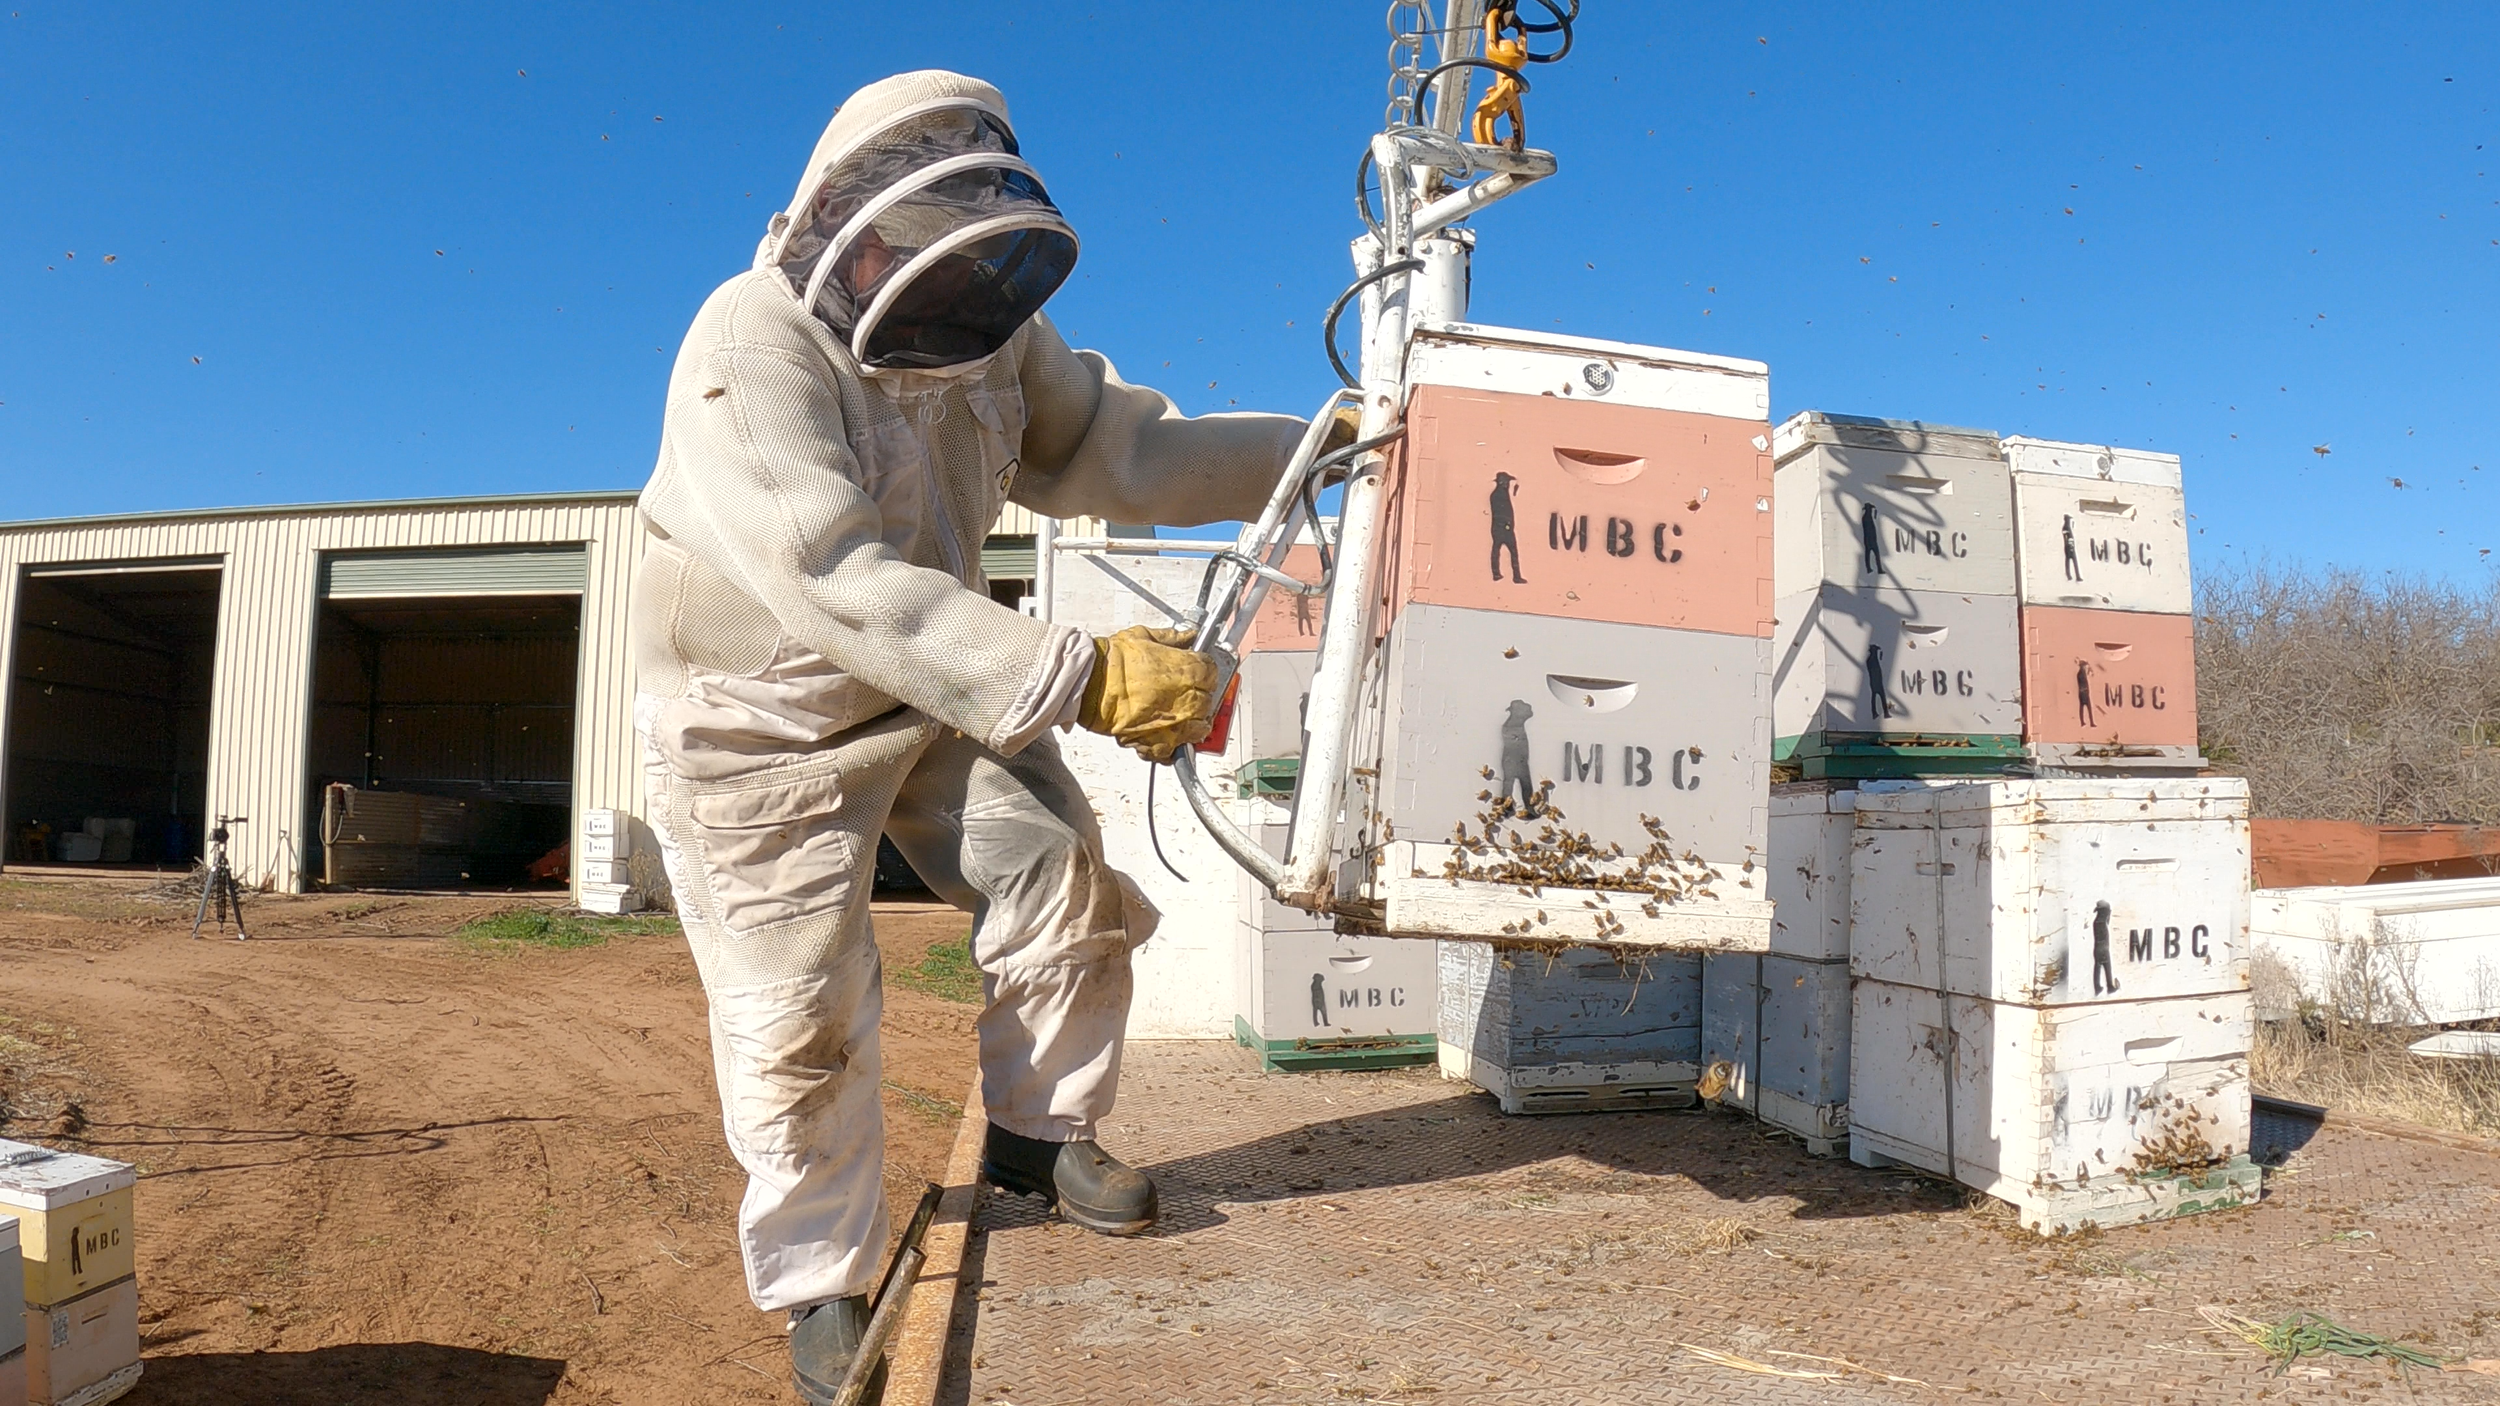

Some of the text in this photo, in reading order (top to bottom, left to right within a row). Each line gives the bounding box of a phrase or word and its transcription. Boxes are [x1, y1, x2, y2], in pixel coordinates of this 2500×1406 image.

[1549, 512, 1683, 563] MBC
[1895, 528, 1967, 558] MBC
[2090, 537, 2153, 567] MBC
[1901, 669, 1974, 697] MBC
[2105, 683, 2166, 710] MBC
[1563, 741, 1701, 791] MBC
[2129, 924, 2209, 962] MBC
[1340, 987, 1405, 1008] MBC
[86, 1227, 119, 1255] MBC
